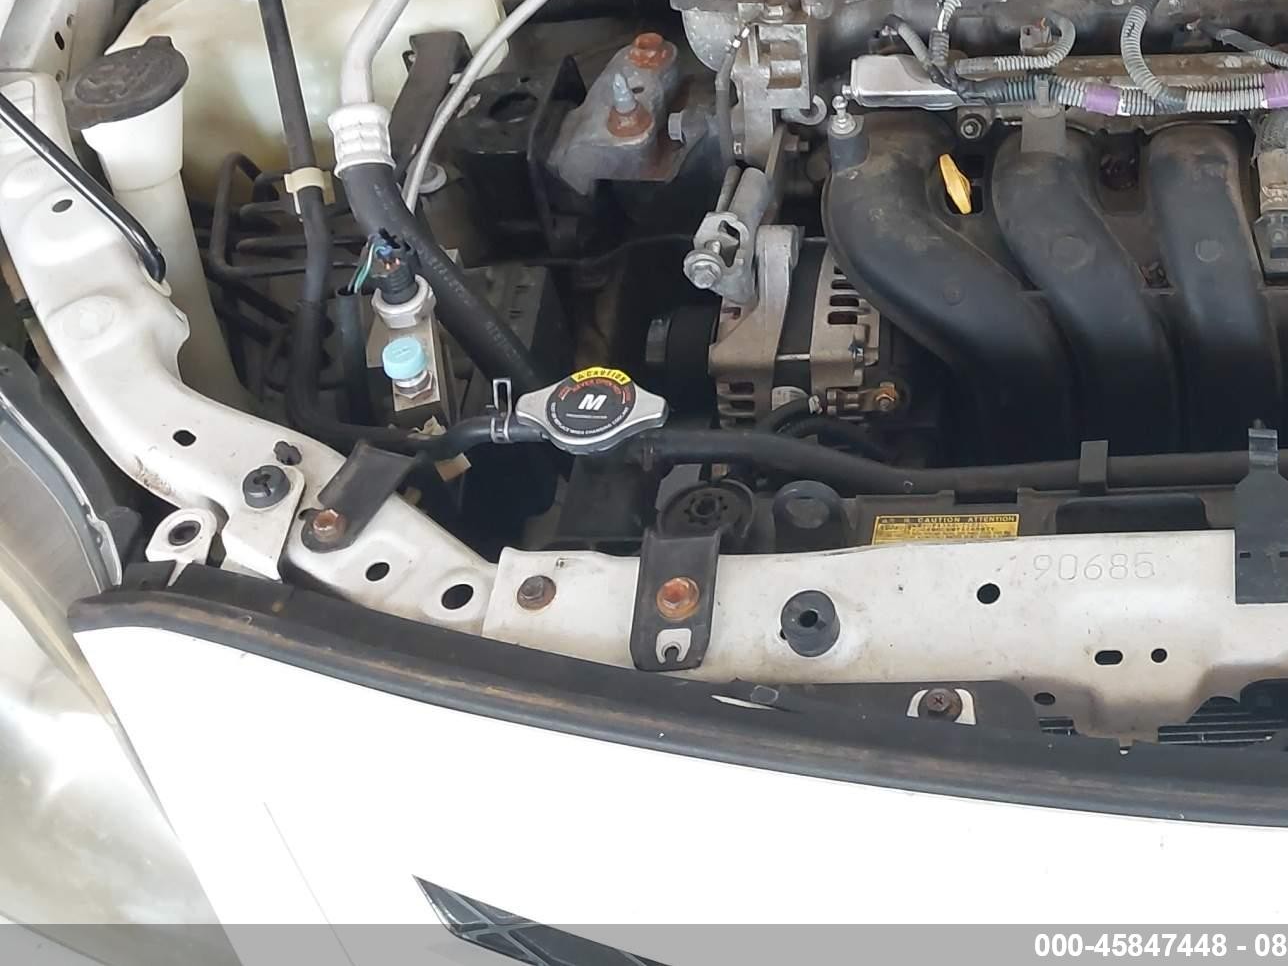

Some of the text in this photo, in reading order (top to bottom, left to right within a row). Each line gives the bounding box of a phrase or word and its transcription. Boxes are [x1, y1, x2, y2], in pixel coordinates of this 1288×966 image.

[586, 369, 627, 383] CAUTION
[577, 393, 607, 410] M
[918, 516, 961, 524] CAUTION
[967, 514, 1016, 523] ATTENTION
